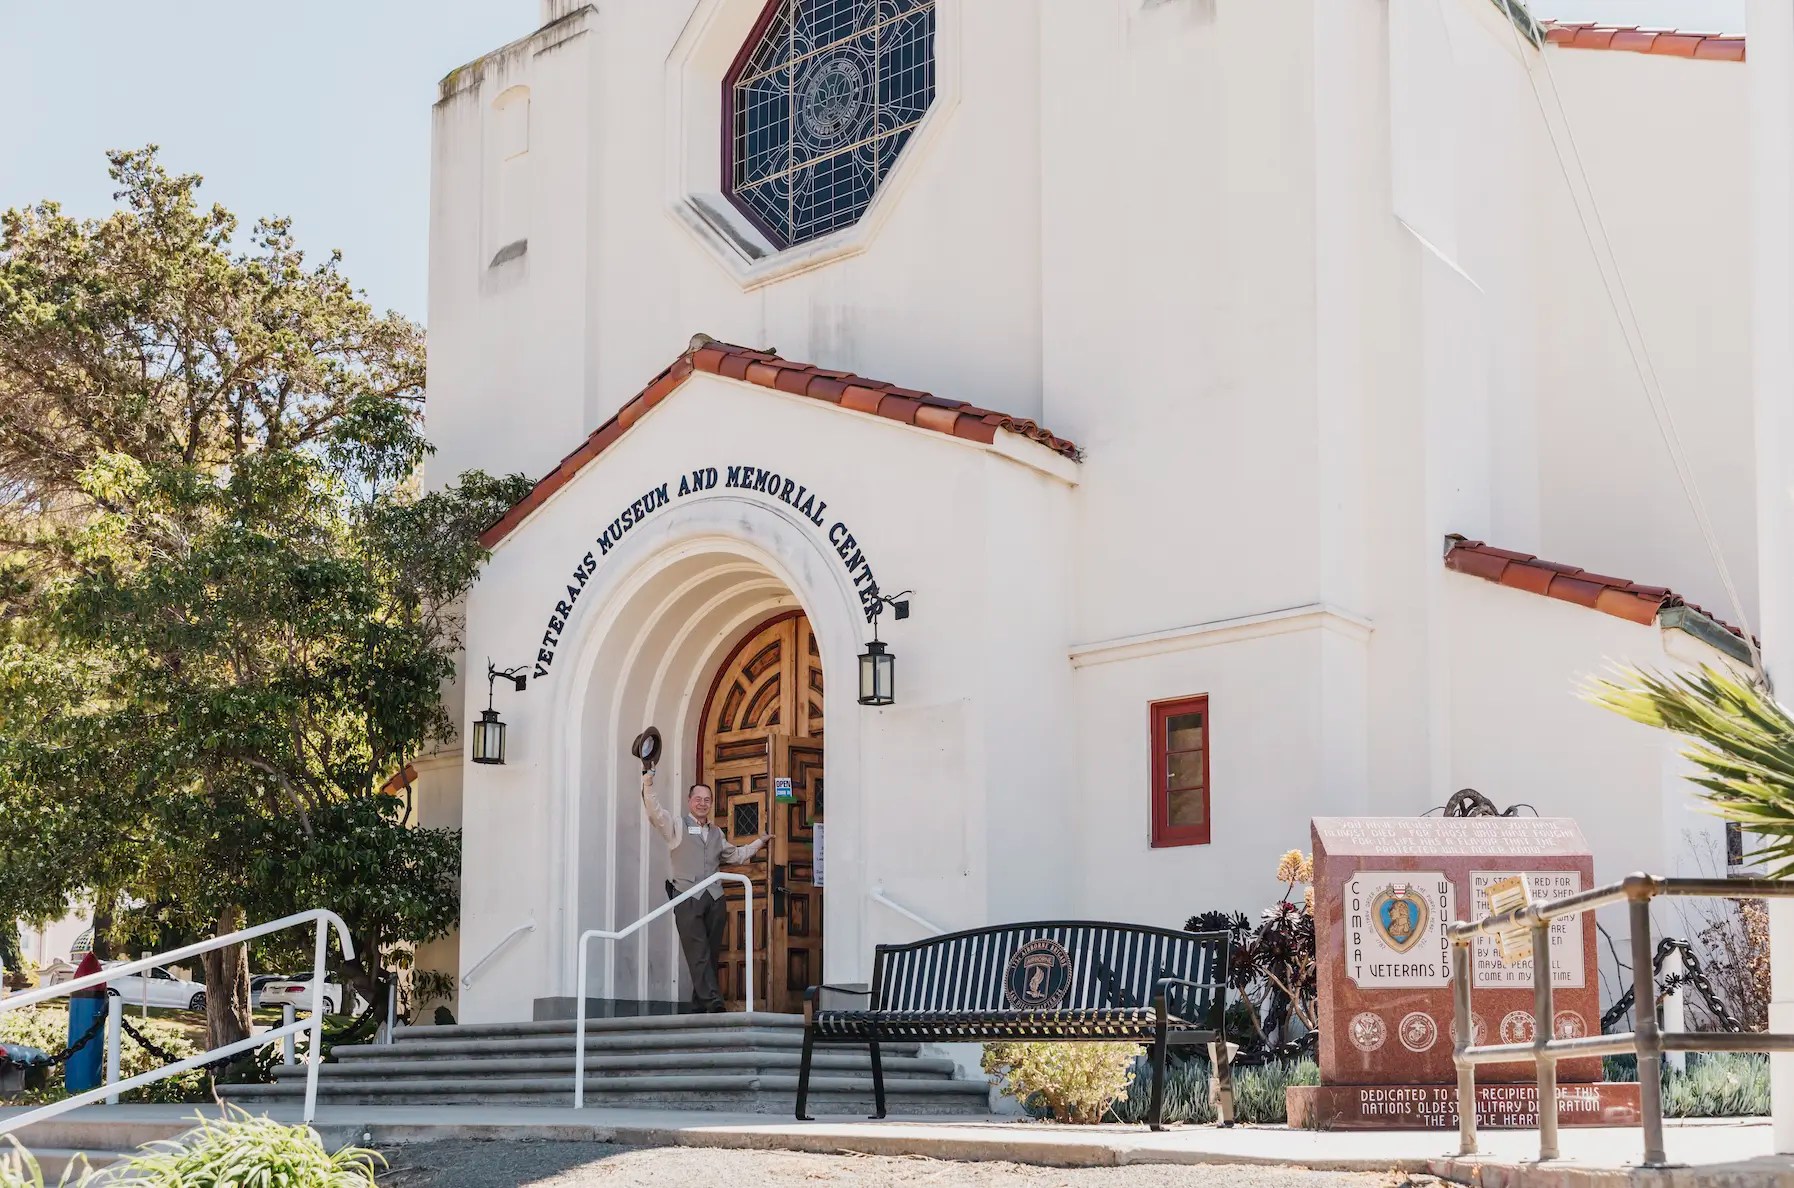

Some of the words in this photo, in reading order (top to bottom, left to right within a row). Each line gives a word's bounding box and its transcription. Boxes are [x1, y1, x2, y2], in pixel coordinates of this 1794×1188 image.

[533, 551, 597, 679] VETERANS
[596, 483, 670, 555] MUSEUM
[678, 467, 718, 497] AND
[725, 466, 827, 527] MEMORIAL
[829, 522, 884, 623] CENTER
[776, 780, 791, 788] OPEN
[1376, 845, 1437, 854] PROTECTED
[1475, 877, 1488, 886] MY
[1534, 877, 1551, 886] RED
[1554, 877, 1571, 886] FOR
[1531, 889, 1549, 897] HEY
[1351, 881, 1362, 979] COMBAT
[1438, 881, 1450, 978] WOUNDED
[1477, 936, 1484, 945] IF
[1477, 949, 1489, 957] BY
[1511, 960, 1533, 969] PEAC
[1369, 964, 1435, 977] VETERANS
[1478, 972, 1502, 981] COME
[1506, 972, 1514, 981] IN
[1518, 972, 1532, 981] MY
[1361, 1089, 1427, 1102] DEDICATED
[1433, 1089, 1448, 1101] TO
[1482, 1087, 1540, 1100] RECIPIENT
[1575, 1087, 1600, 1099] THIS
[1362, 1102, 1411, 1114] NATIONS
[1418, 1101, 1460, 1114] OLDEST
[1474, 1100, 1522, 1113] ILITARY
[1528, 1100, 1600, 1113] DRATION
[1452, 1113, 1497, 1127] PPLE
